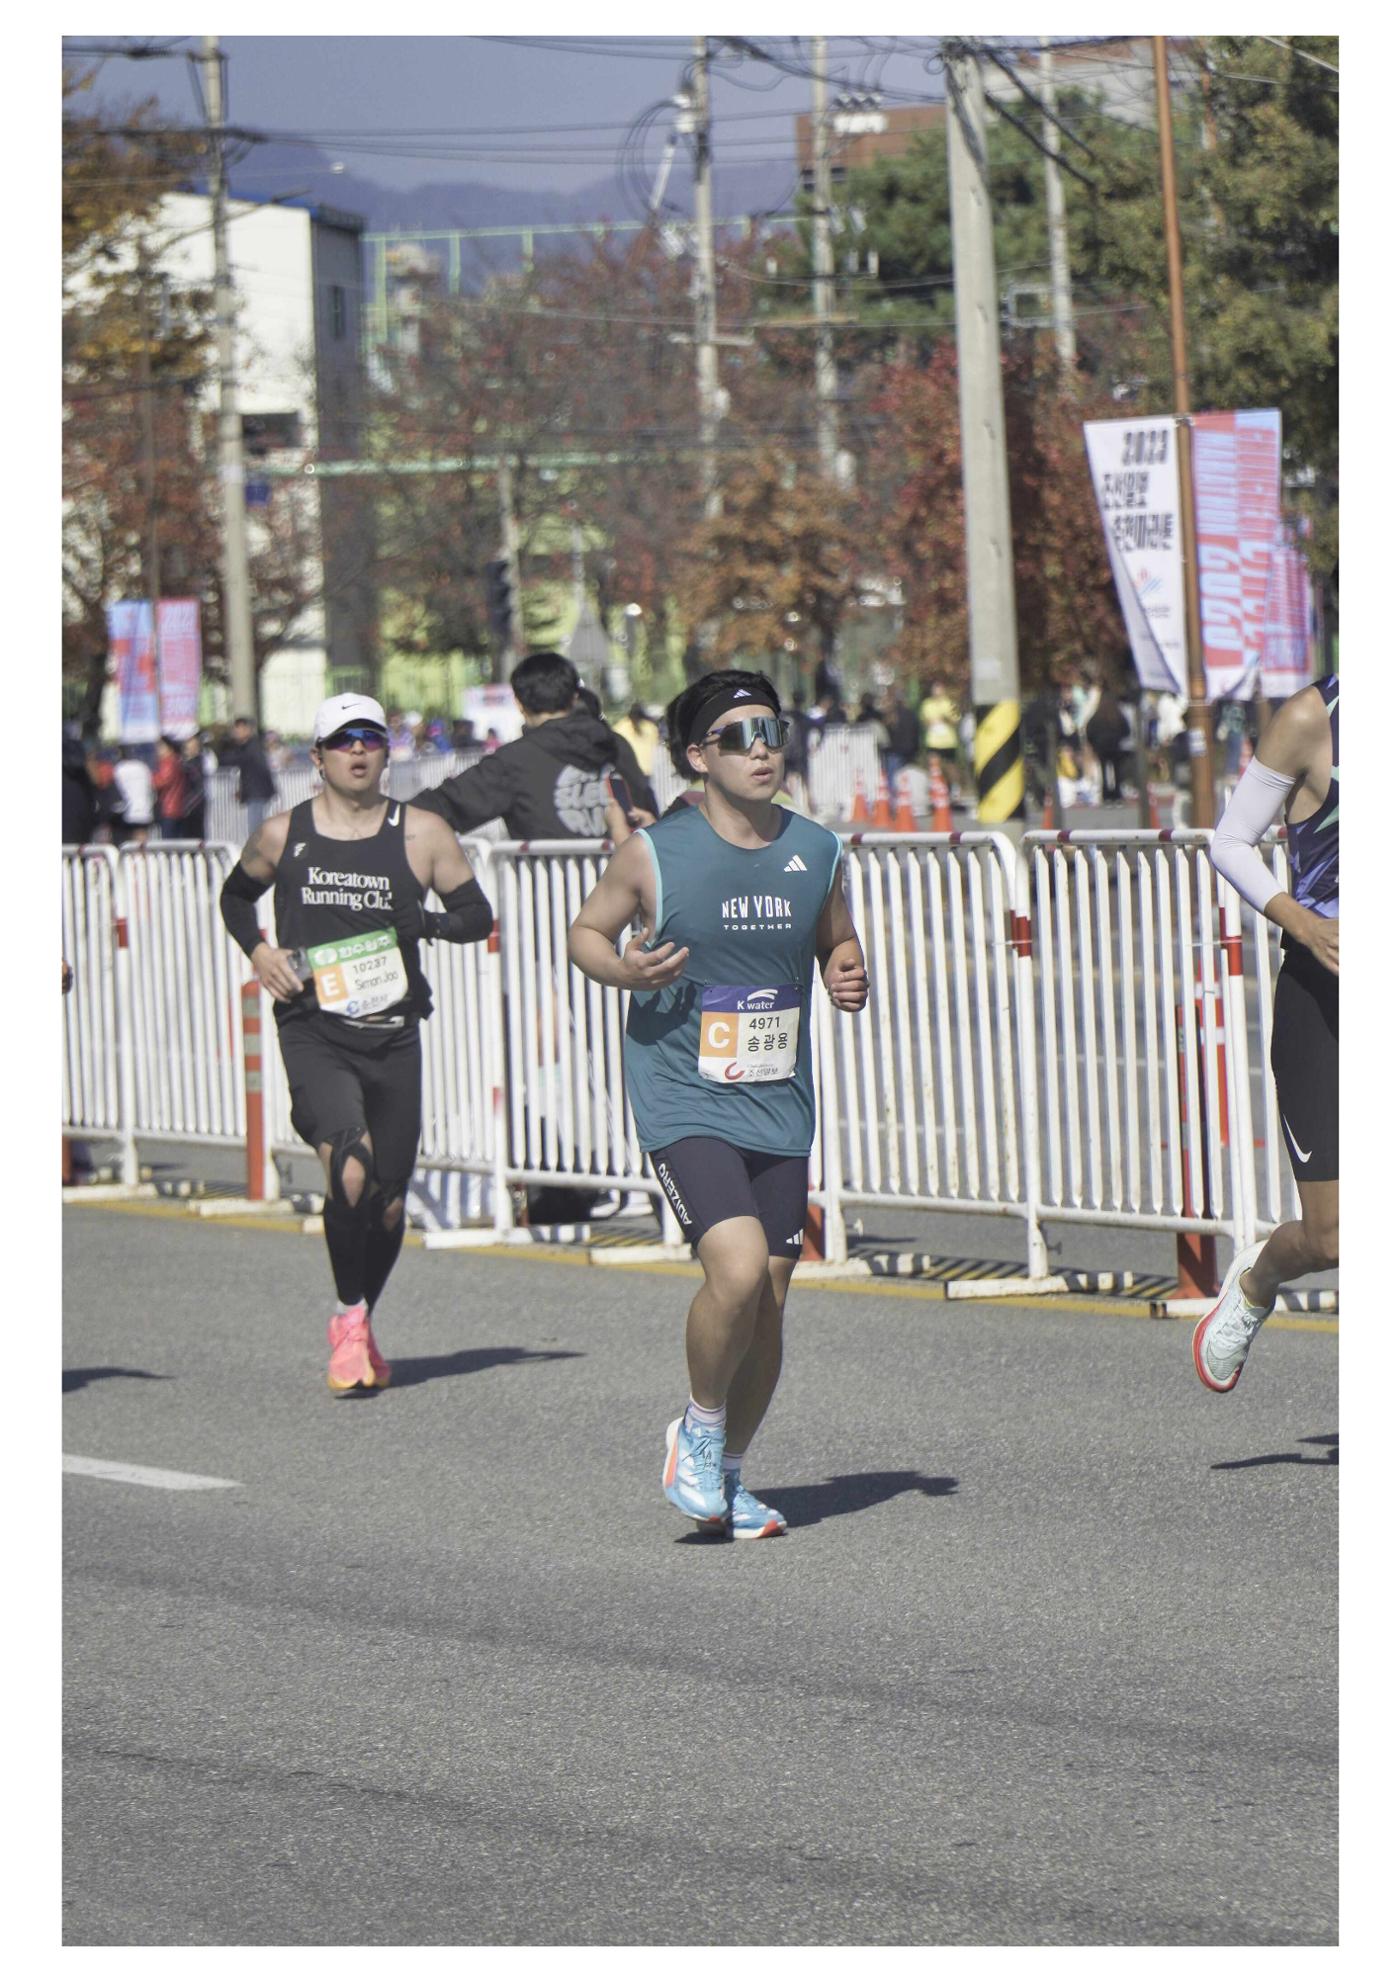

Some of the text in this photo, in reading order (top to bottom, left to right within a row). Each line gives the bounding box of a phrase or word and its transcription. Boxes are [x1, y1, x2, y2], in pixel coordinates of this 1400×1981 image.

[1122, 429, 1169, 466] 2023
[307, 866, 391, 890] Koreatown
[301, 887, 363, 911] Running
[722, 895, 792, 919] NEW YORK
[723, 923, 792, 931] TOGETHER
[352, 956, 387, 975] 10237
[320, 973, 341, 997] E
[737, 1000, 775, 1010] K water
[707, 1021, 730, 1049] C
[749, 1016, 780, 1030] 4971
[658, 1162, 693, 1226] ADIZERO
